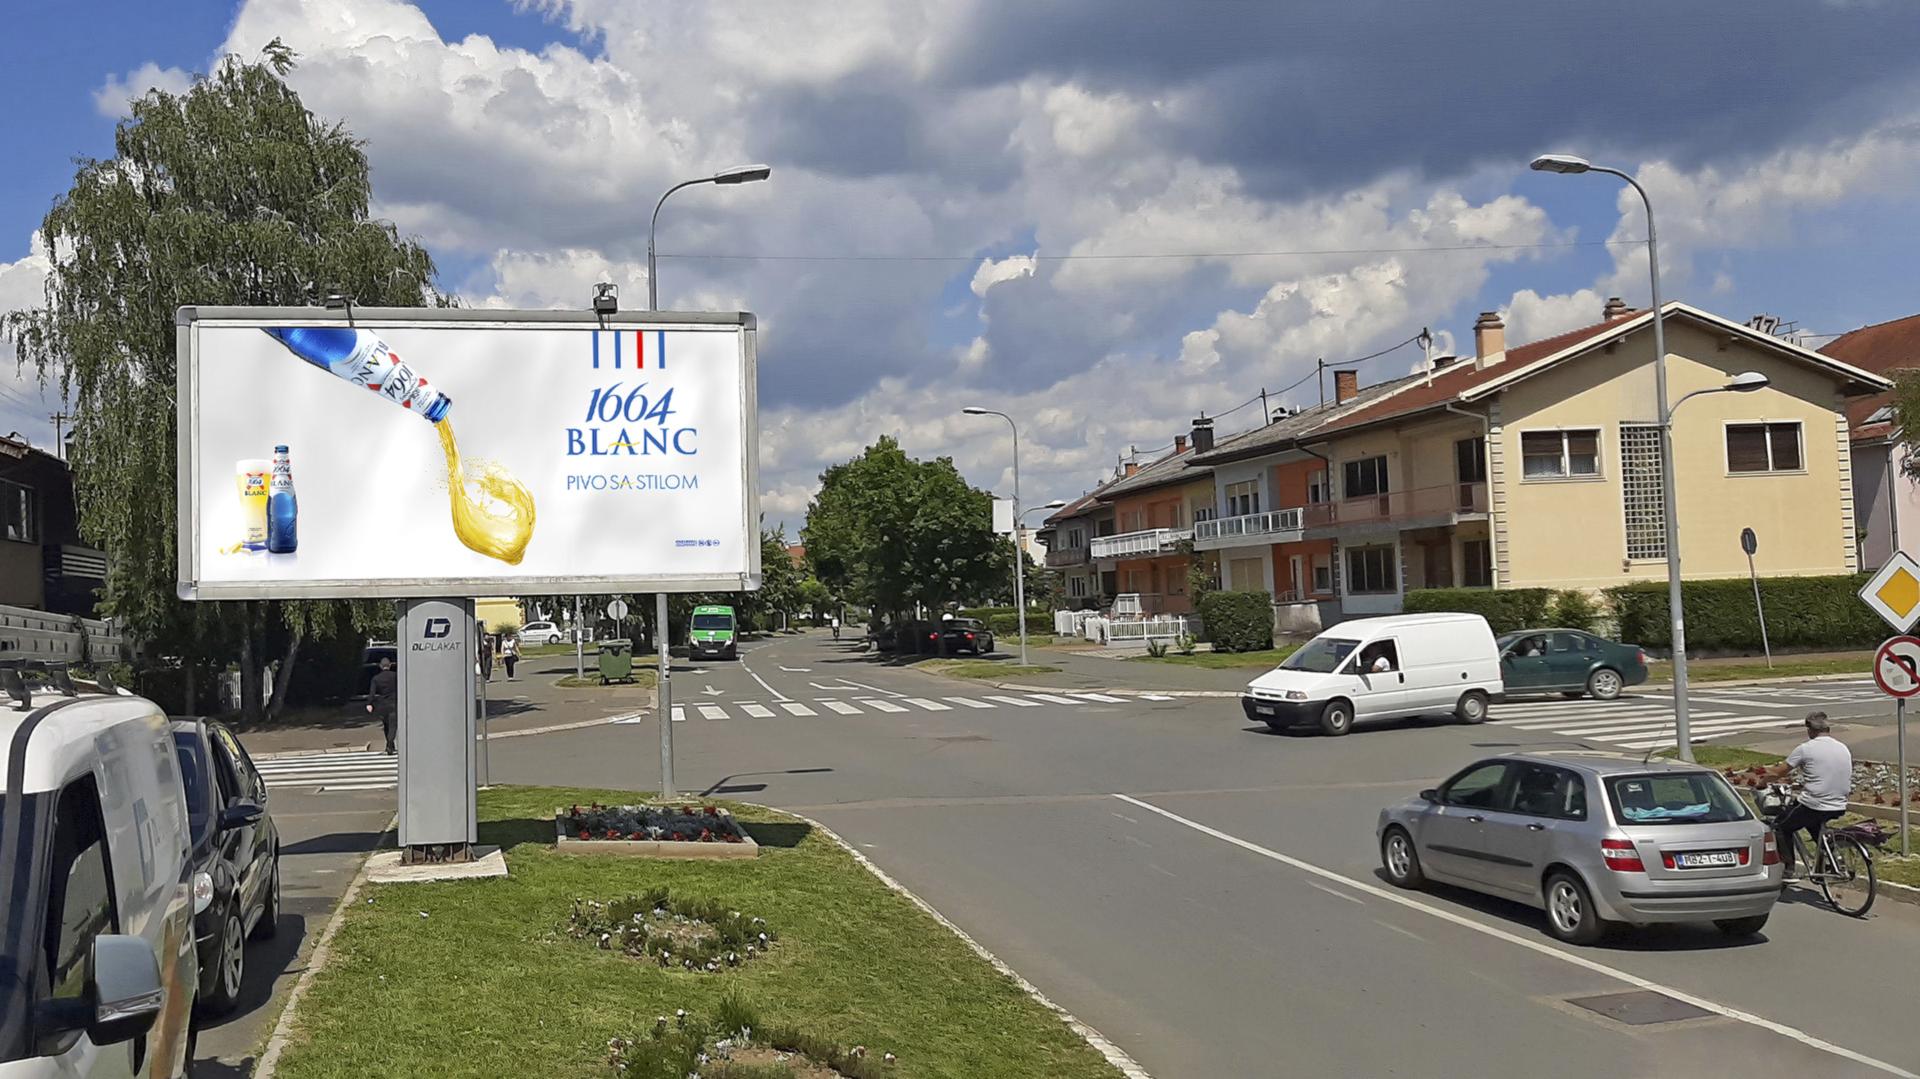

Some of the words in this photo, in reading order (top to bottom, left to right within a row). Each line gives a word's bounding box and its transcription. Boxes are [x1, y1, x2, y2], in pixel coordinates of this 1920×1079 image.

[351, 340, 389, 387] BLANC
[384, 364, 413, 400] 1664
[585, 381, 677, 426] 1664
[565, 427, 698, 456] BLANC
[566, 474, 607, 490] PIVO
[610, 474, 633, 490] SA
[636, 473, 699, 490] STILOM
